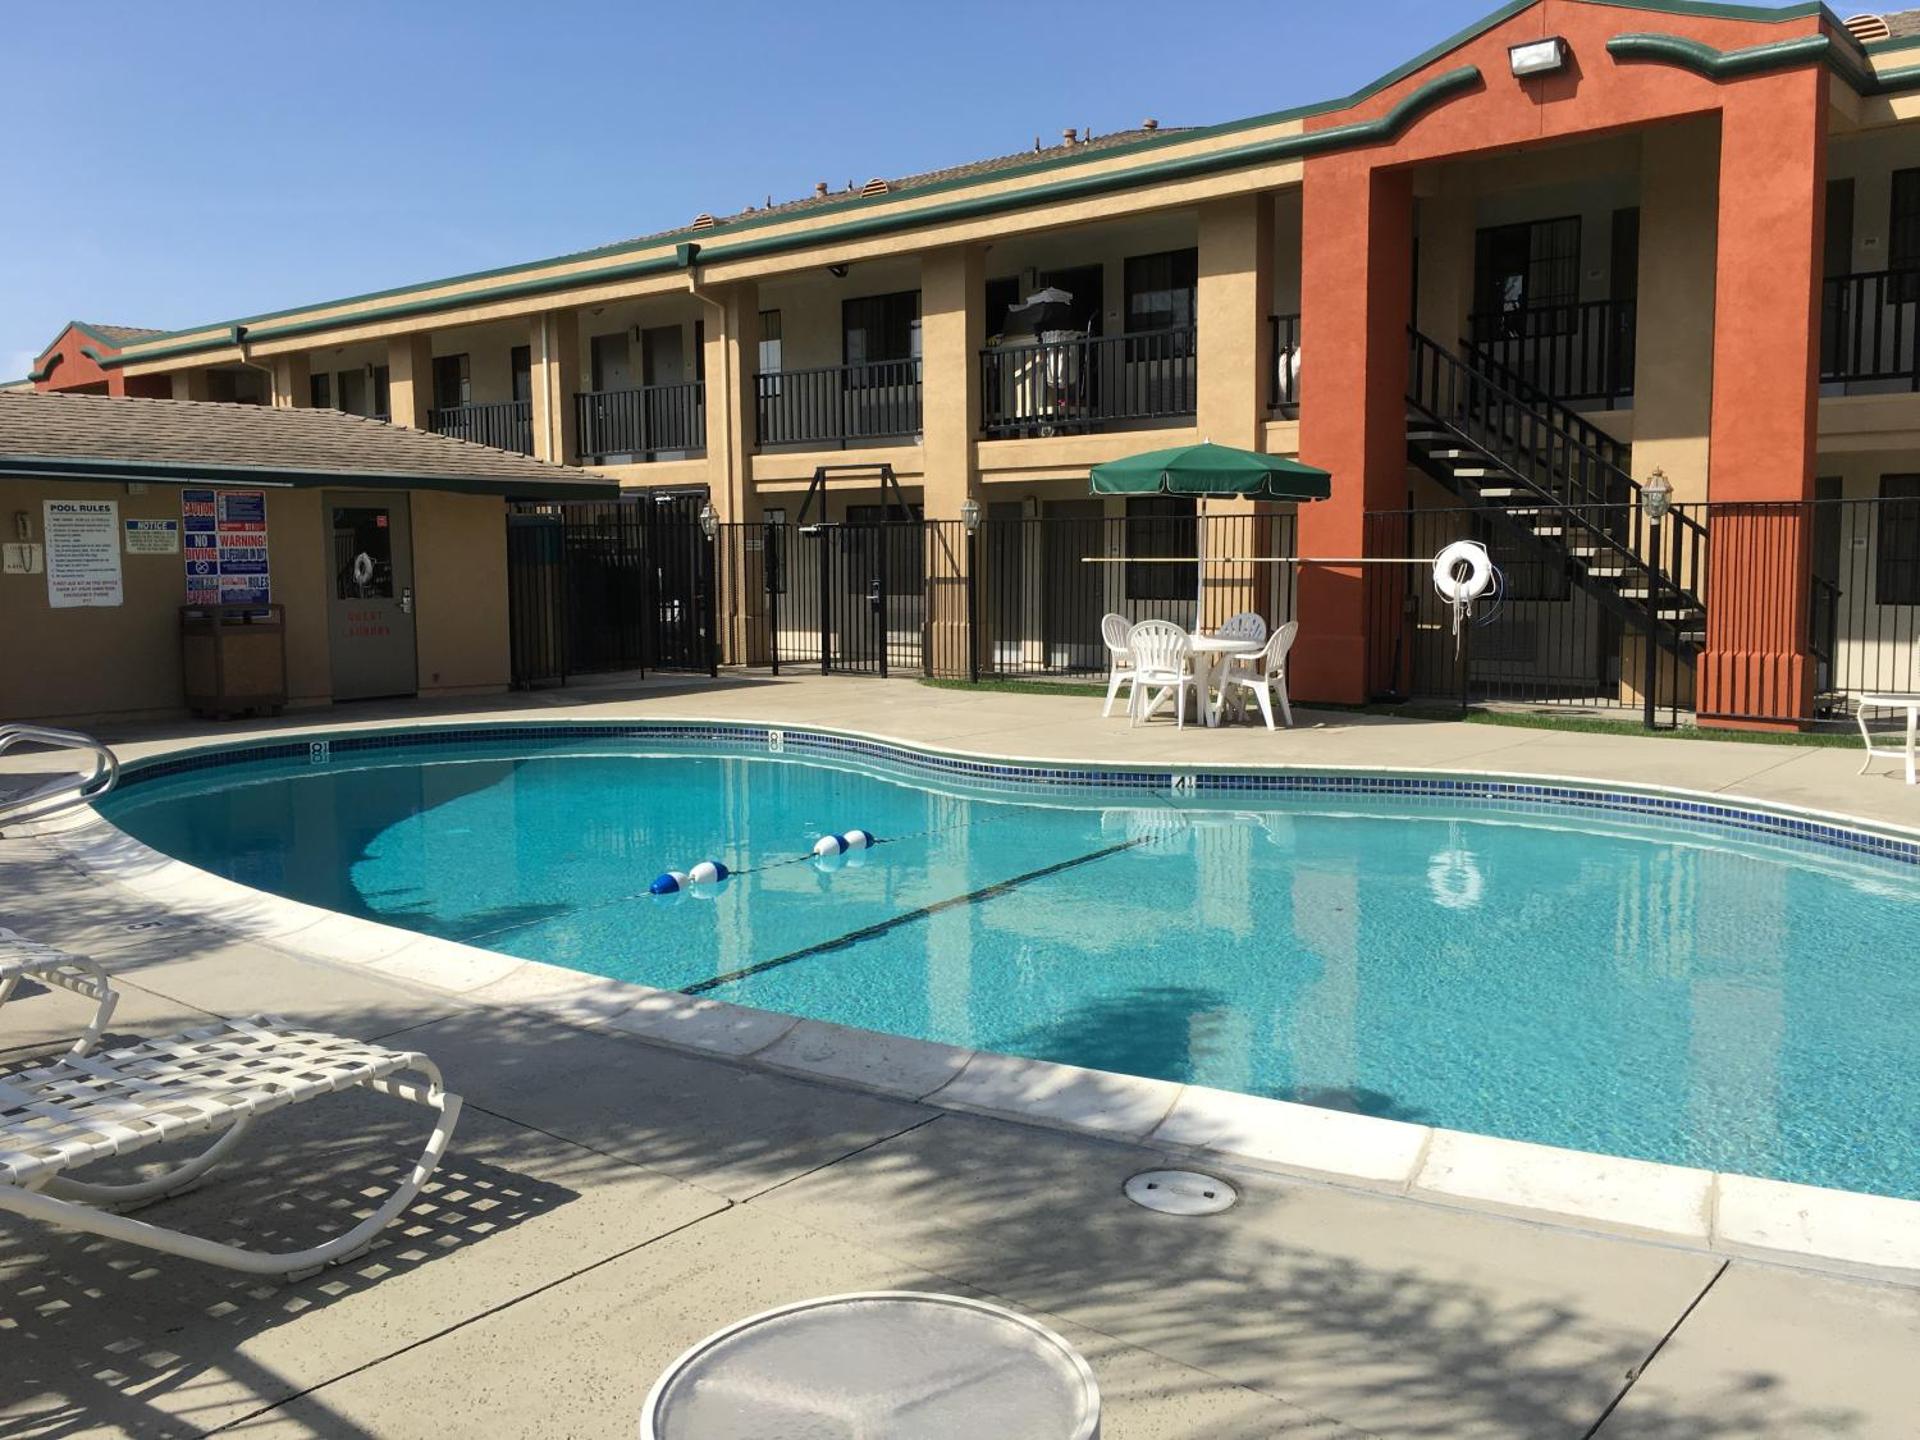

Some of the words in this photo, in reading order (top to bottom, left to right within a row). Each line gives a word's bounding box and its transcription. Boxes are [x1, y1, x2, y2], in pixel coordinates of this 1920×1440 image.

[50, 504, 77, 512] POOL
[80, 504, 111, 512] RULES
[183, 502, 215, 516] CAUTION
[137, 521, 168, 530] NOTICE
[194, 535, 208, 547] NO
[220, 534, 267, 547] WARNING!
[184, 548, 217, 561] DIVING
